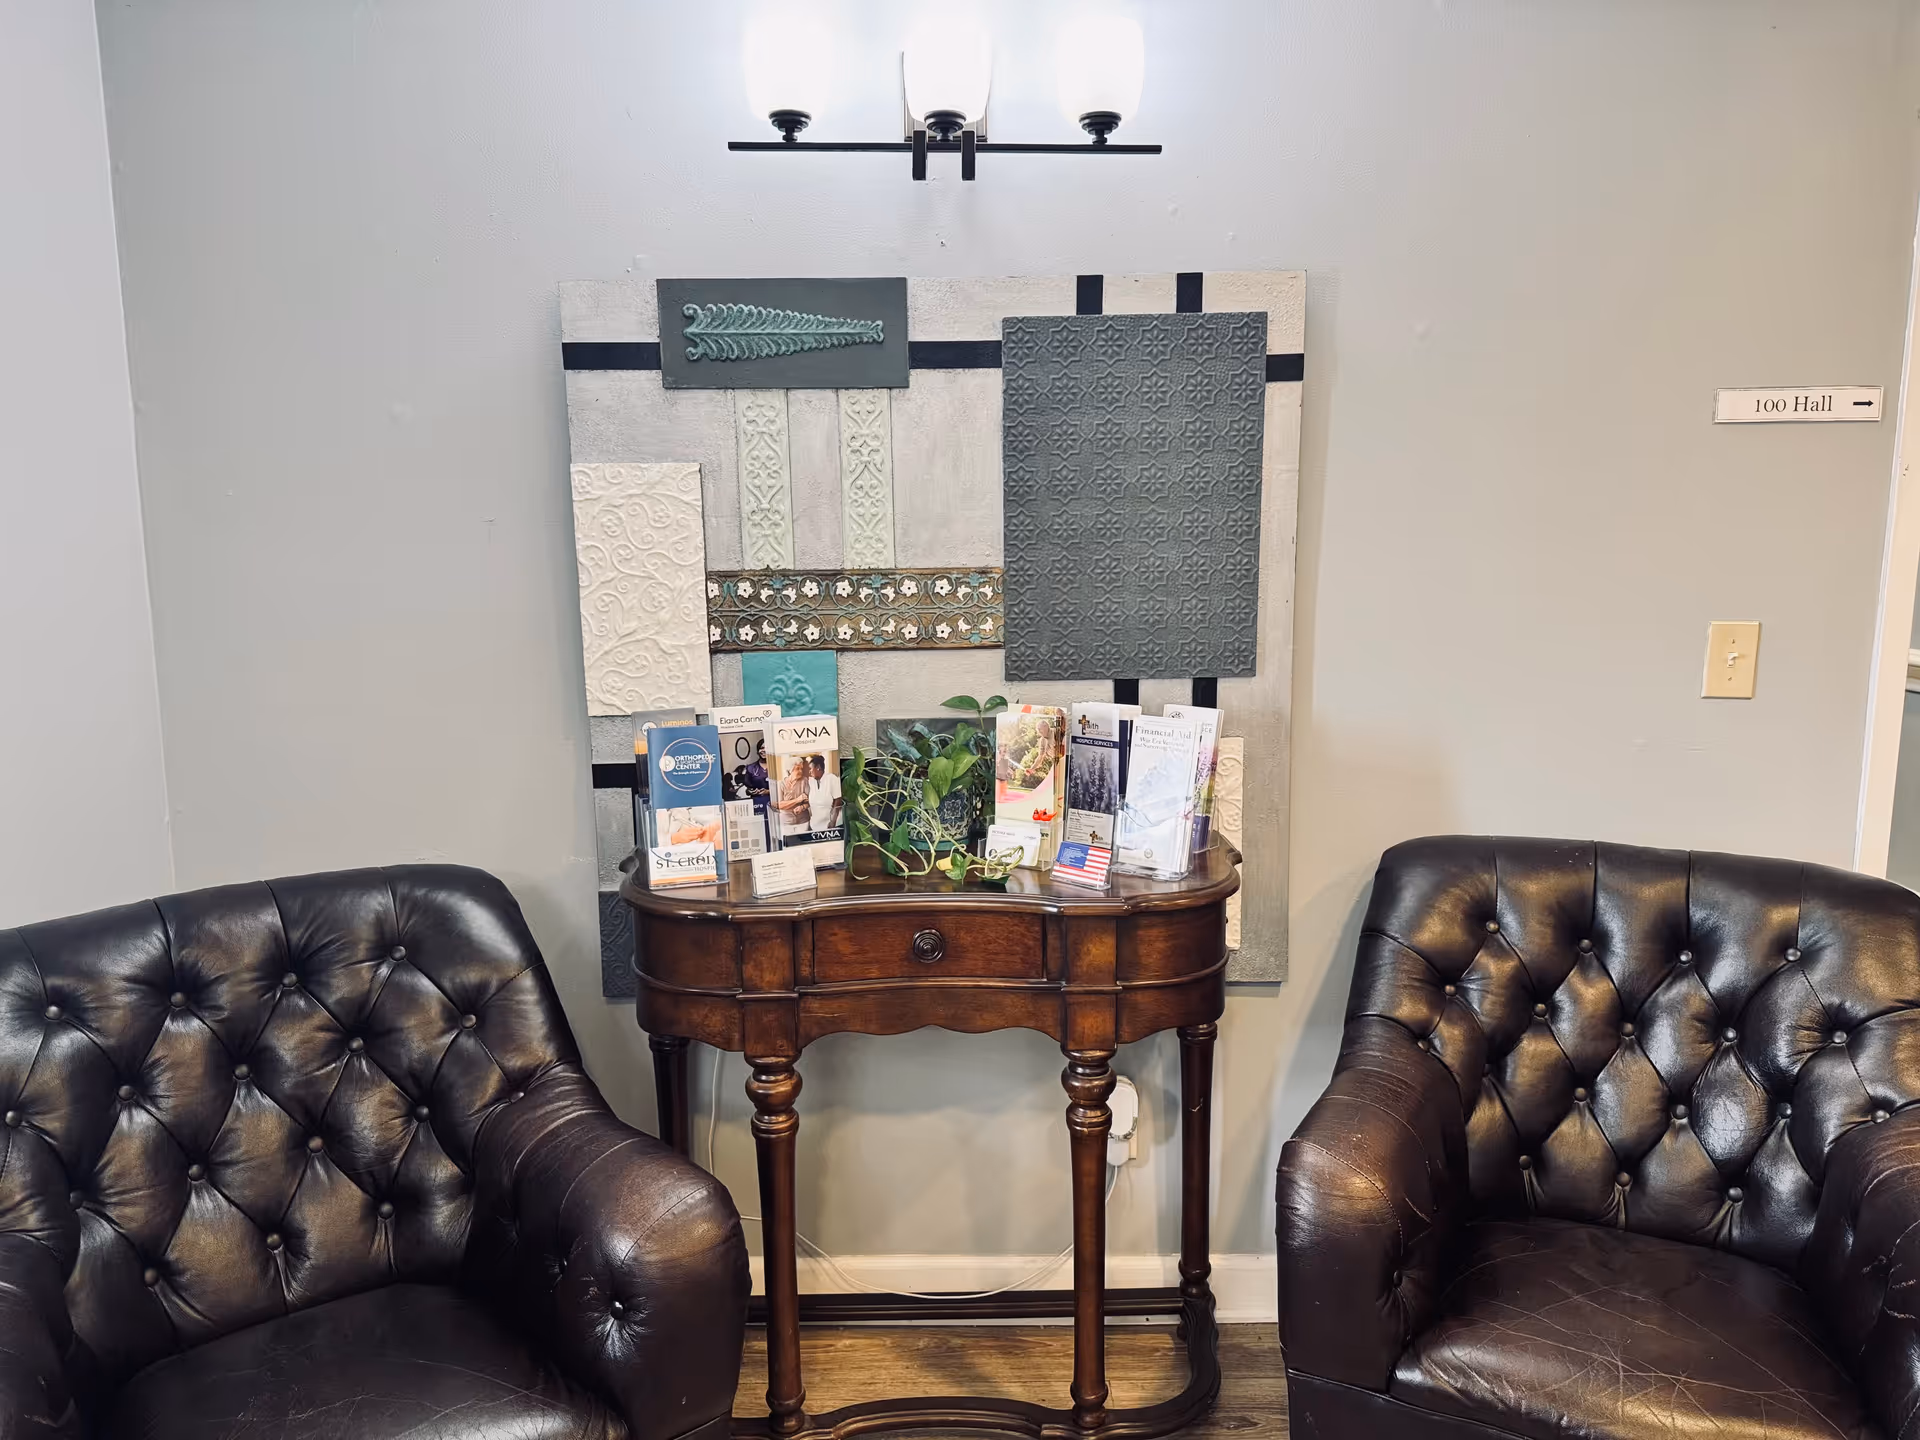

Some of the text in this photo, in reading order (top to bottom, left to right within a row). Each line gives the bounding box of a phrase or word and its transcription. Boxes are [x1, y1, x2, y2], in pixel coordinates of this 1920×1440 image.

[1755, 395, 1833, 413] 100 Hall
[719, 716, 739, 725] Elara
[793, 726, 831, 739] VNA
[1135, 725, 1192, 740] Financial Aid
[1093, 740, 1114, 748] SERVICES
[674, 753, 716, 762] ORTHOPEDIC
[818, 830, 841, 838] VNA
